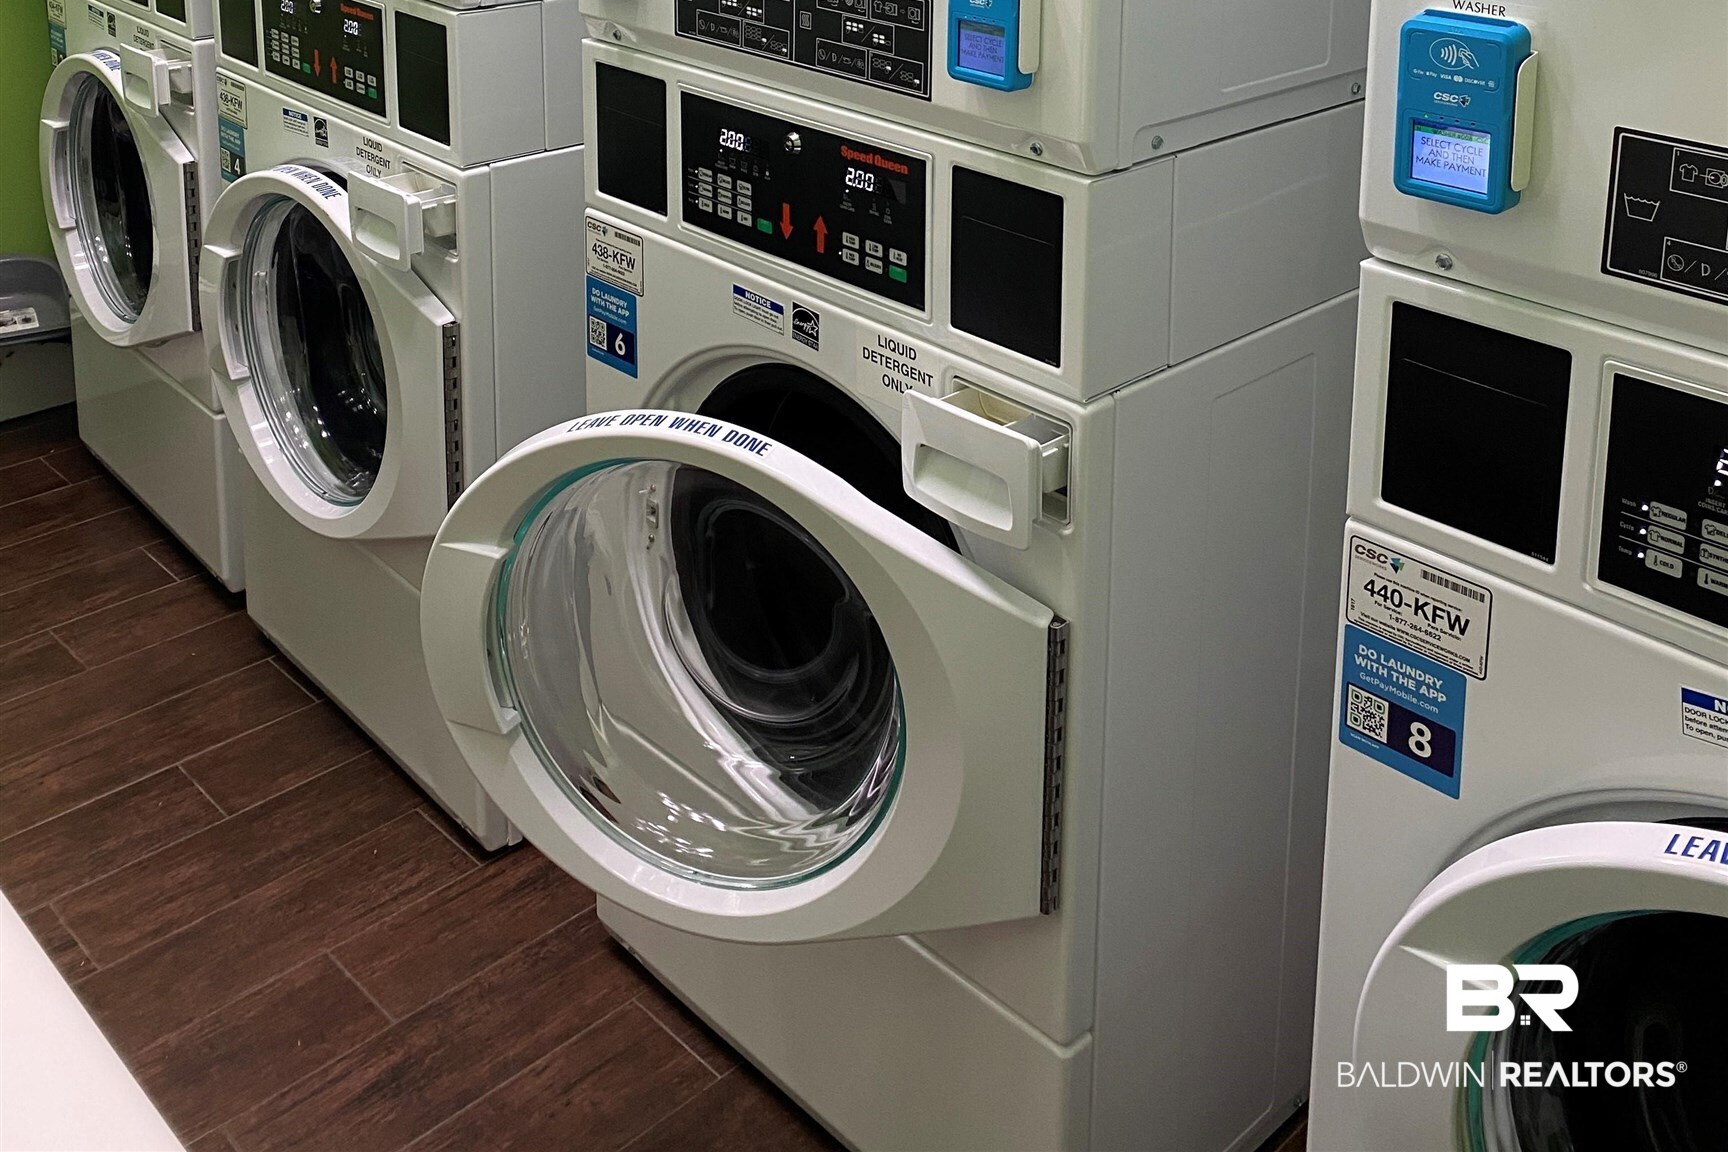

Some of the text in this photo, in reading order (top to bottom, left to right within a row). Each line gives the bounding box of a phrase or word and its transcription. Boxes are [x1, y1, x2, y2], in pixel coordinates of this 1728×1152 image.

[1440, 73, 1452, 81] VISA
[1433, 91, 1459, 103] CSC
[363, 136, 383, 152] LIQUID
[1421, 136, 1484, 156] SELECT CYCLE
[234, 158, 241, 175] 4
[356, 147, 391, 170] DETERGENT
[841, 145, 909, 175] Speed Queen
[1416, 156, 1487, 177] MAKE PAYMENT
[1428, 148, 1475, 165] AND THEN
[366, 165, 382, 178] ONLY
[845, 167, 875, 192] 2.00
[291, 170, 322, 185] WHEN
[312, 181, 342, 200] DONE
[587, 221, 601, 232] CSC
[592, 242, 635, 270] 438-KFW
[591, 295, 630, 318] WITH THE APP
[592, 288, 628, 309] DO LAUNDRY
[745, 291, 772, 309] NOTICE
[615, 332, 626, 356] 6
[877, 334, 917, 361] LIQUID
[862, 346, 933, 387] DETERGENT
[567, 413, 773, 457] LEAVE OPEN WHEN DONE
[1621, 498, 1637, 508] Wash
[1619, 521, 1635, 531] Cycle
[1661, 510, 1686, 524] REGULAR
[1618, 545, 1632, 556] Temp
[1660, 536, 1683, 548] NORMAL
[1355, 544, 1388, 564] CSC
[1659, 560, 1674, 570] COLD
[1363, 579, 1471, 637] 440-KFW
[1389, 613, 1442, 642] 1-877-264-6622
[1358, 644, 1377, 660] DO
[1380, 654, 1444, 690] LAUNDRY
[1354, 653, 1447, 703] WITH THE APP
[1359, 672, 1439, 714] GetPayMobile.com
[1685, 707, 1707, 719] DOOR
[1685, 715, 1708, 728] before
[1408, 721, 1432, 758] 8
[1685, 723, 1694, 731] To
[1695, 728, 1716, 739] open,
